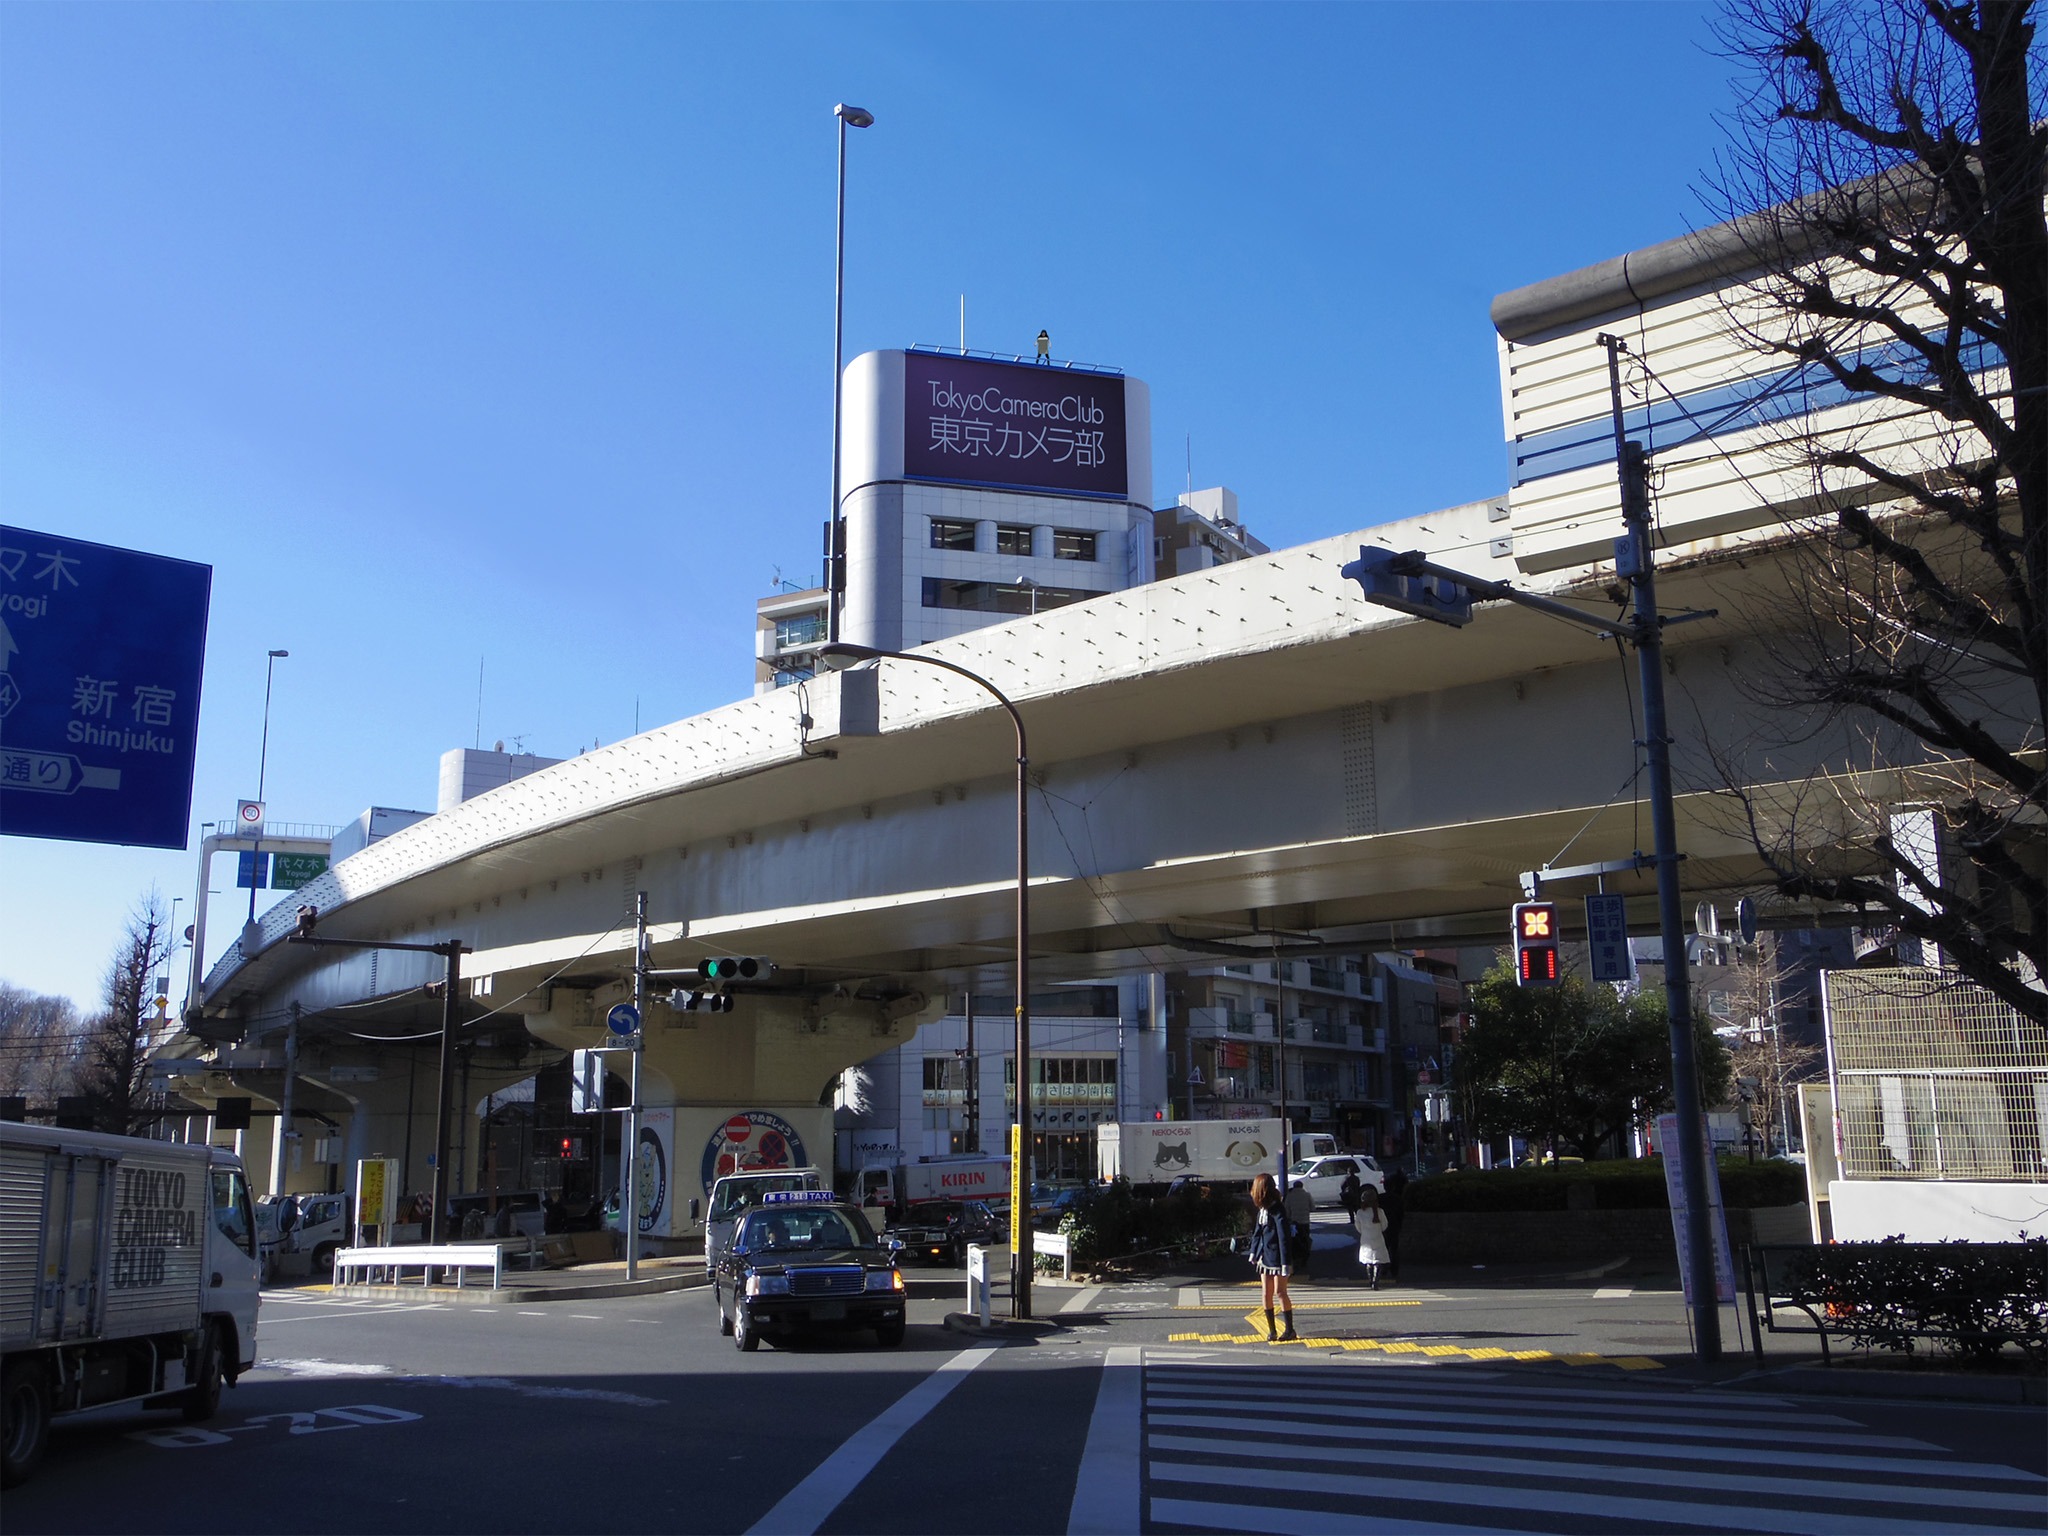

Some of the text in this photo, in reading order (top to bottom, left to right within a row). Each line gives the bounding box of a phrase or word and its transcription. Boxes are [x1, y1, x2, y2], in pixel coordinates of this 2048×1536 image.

[928, 380, 1104, 424] TokyoCameraClub
[928, 414, 1105, 468] 東京カメラ部
[72, 674, 176, 727] 新宿
[66, 720, 174, 754] Shinjuku
[2, 756, 61, 784] 通り
[246, 808, 256, 818] 50
[278, 857, 320, 870] 代々木
[286, 870, 311, 878] Yoyogi
[1034, 1085, 1114, 1097] かさはら歯科
[121, 1168, 186, 1210] TOKYO
[941, 1171, 985, 1187] KIRIN
[809, 1192, 831, 1200] TAXI
[117, 1207, 196, 1248] CAMERA
[113, 1247, 166, 1289] CLUB
